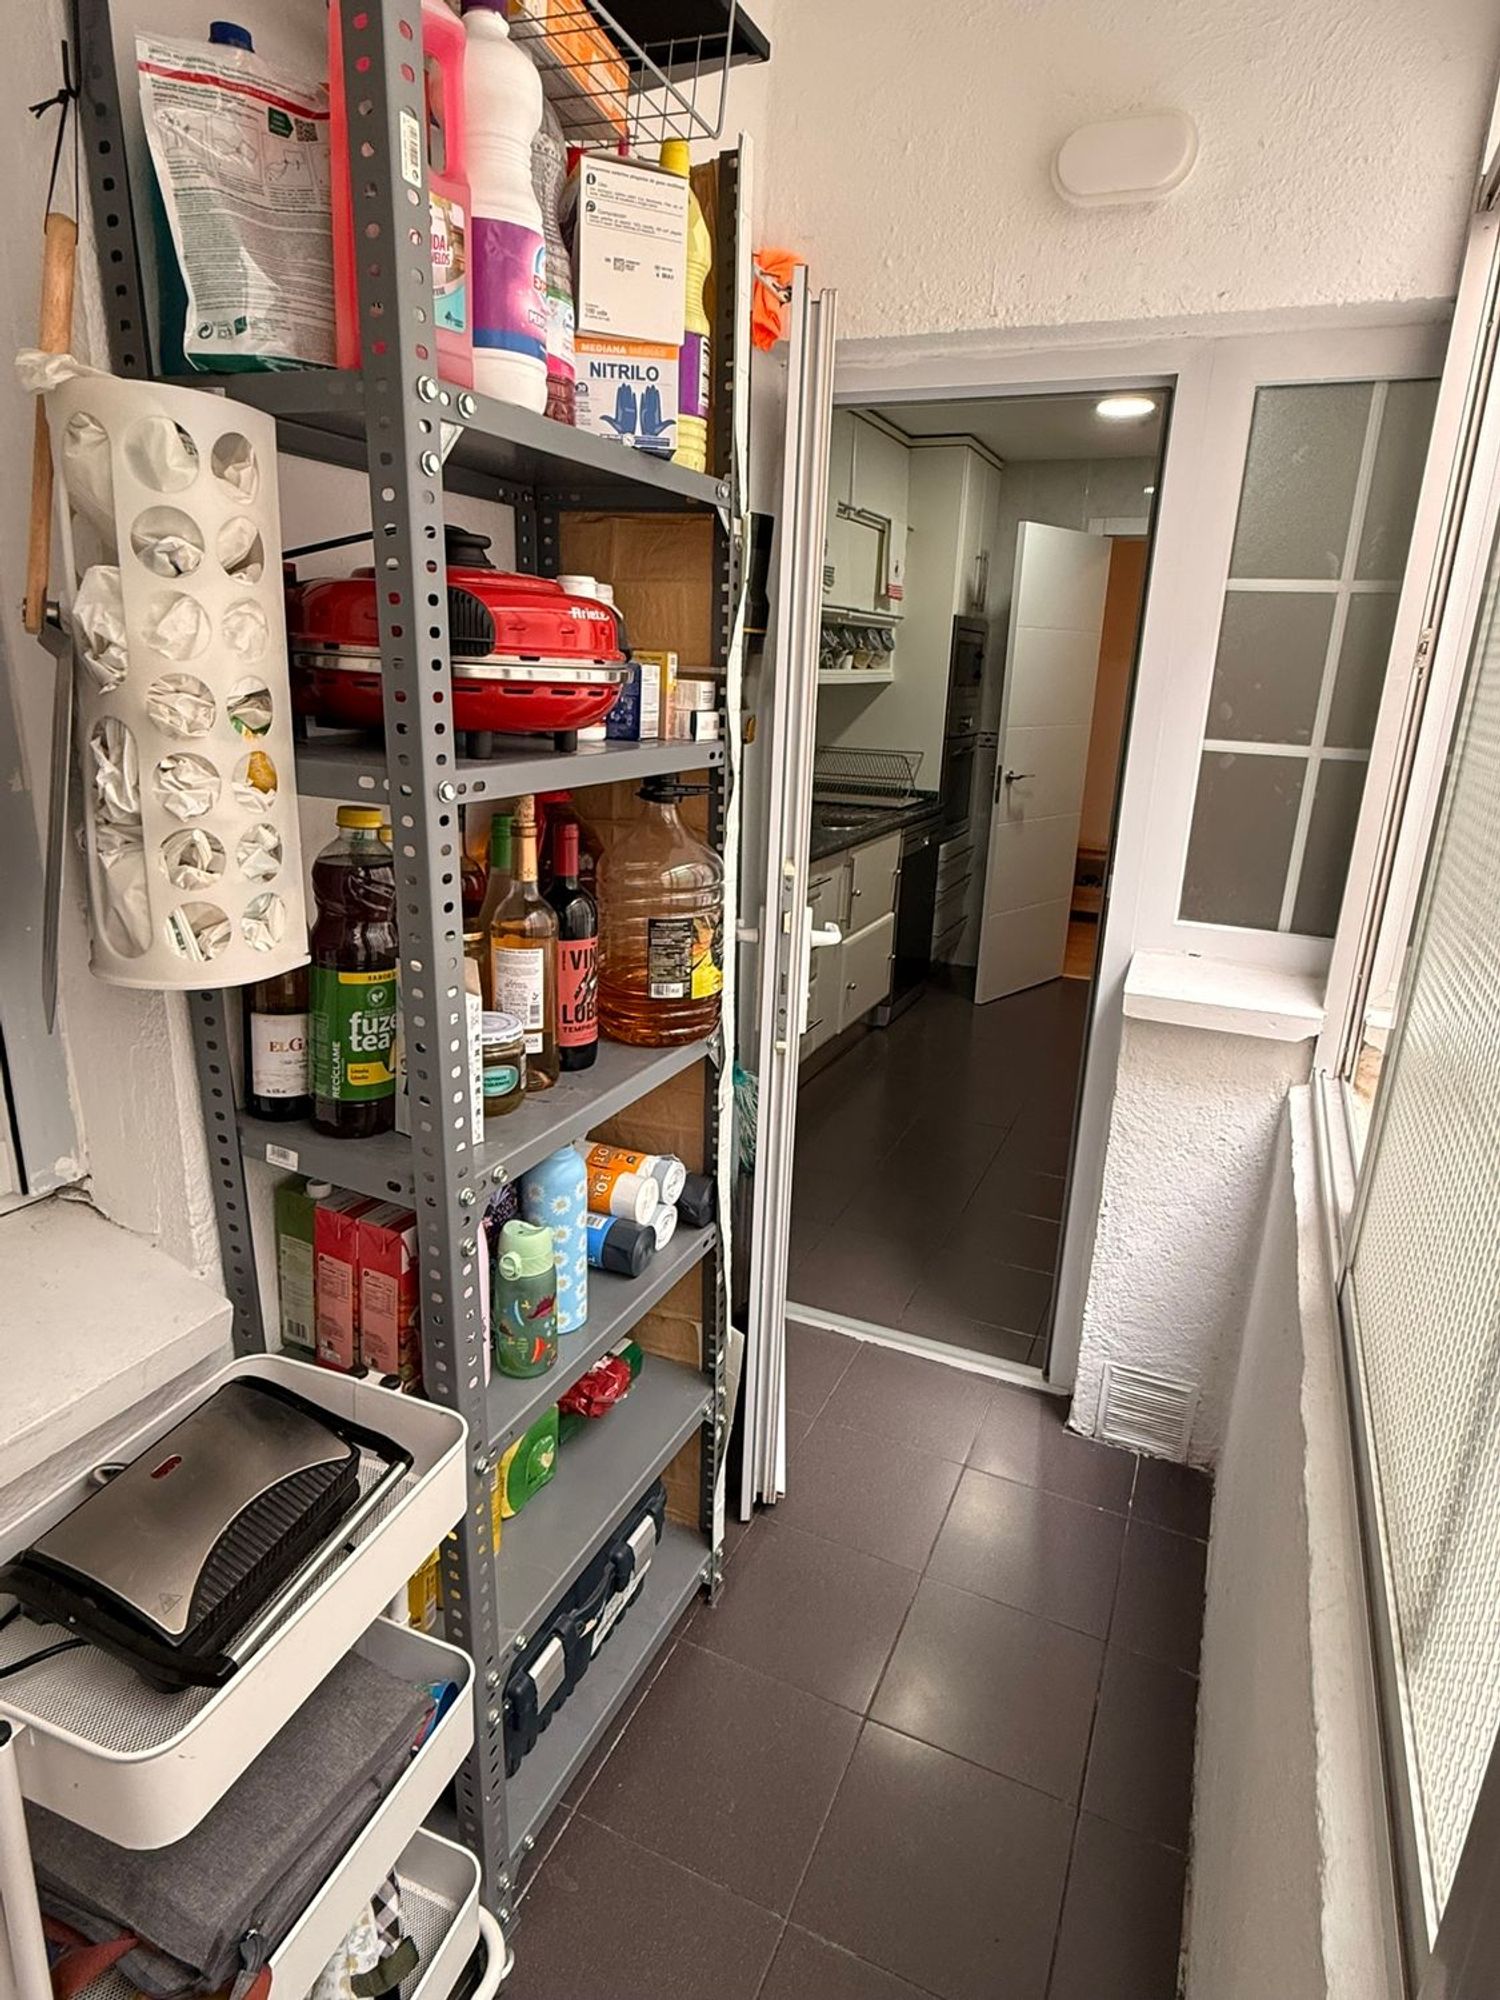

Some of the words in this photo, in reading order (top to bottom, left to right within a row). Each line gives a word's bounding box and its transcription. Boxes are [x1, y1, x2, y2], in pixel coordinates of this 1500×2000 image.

[581, 342, 627, 354] MEDIANA
[589, 361, 660, 382] NITRILO
[349, 1011, 396, 1036] fuze
[349, 1031, 390, 1052] tea
